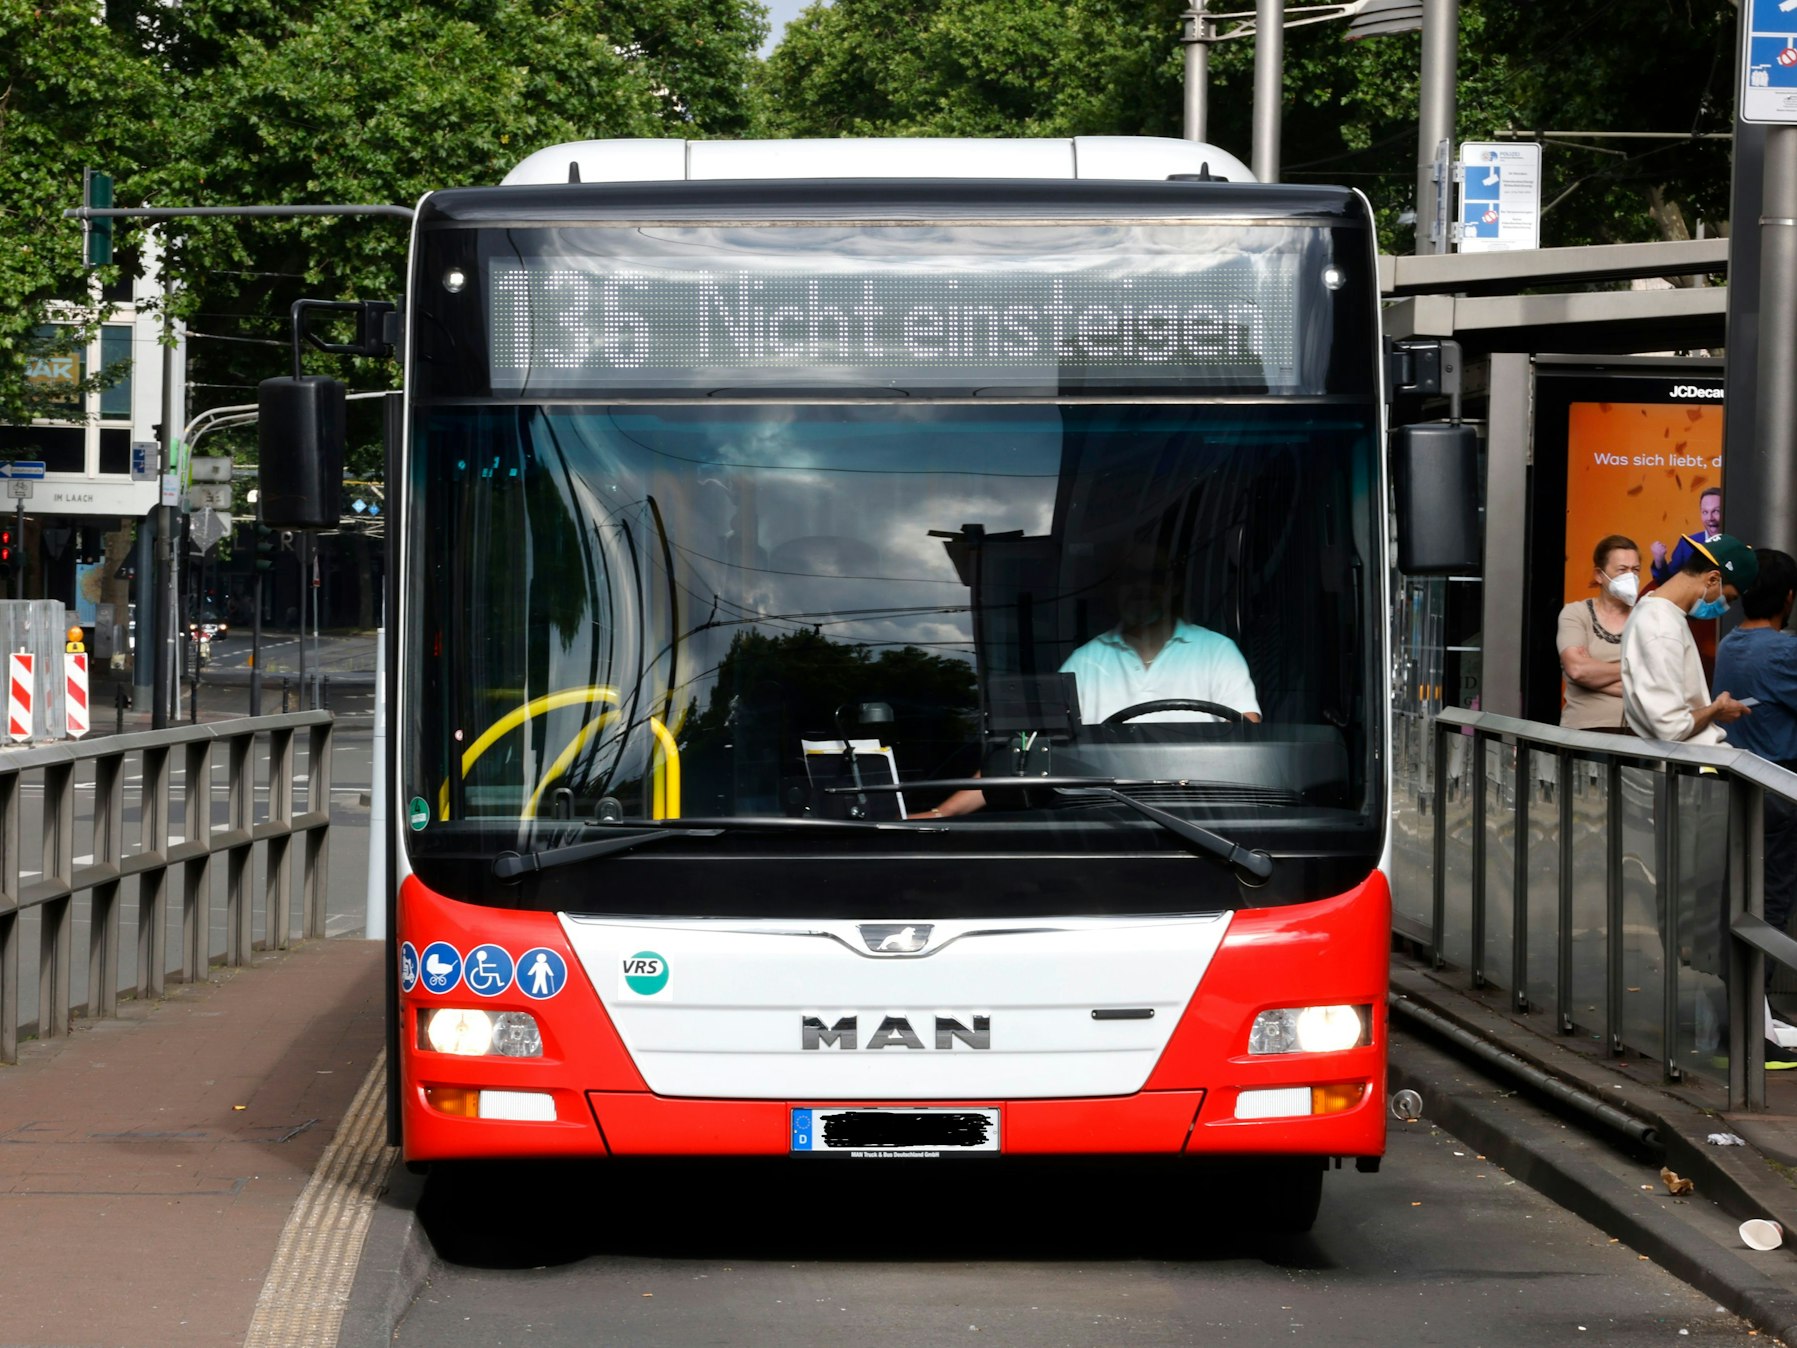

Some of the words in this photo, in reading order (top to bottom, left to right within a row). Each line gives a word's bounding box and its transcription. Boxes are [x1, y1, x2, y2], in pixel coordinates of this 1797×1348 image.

[499, 270, 649, 367] 136
[700, 270, 884, 357] Nicht
[904, 279, 1263, 361] einsteigen
[1594, 452, 1629, 466] Was
[1633, 453, 1664, 466] sich
[1669, 454, 1707, 469] liebt,
[54, 494, 63, 502] IM
[66, 494, 94, 502] LAACH
[623, 960, 658, 973] VRS
[801, 1010, 991, 1050] MAN
[798, 1134, 808, 1145] D
